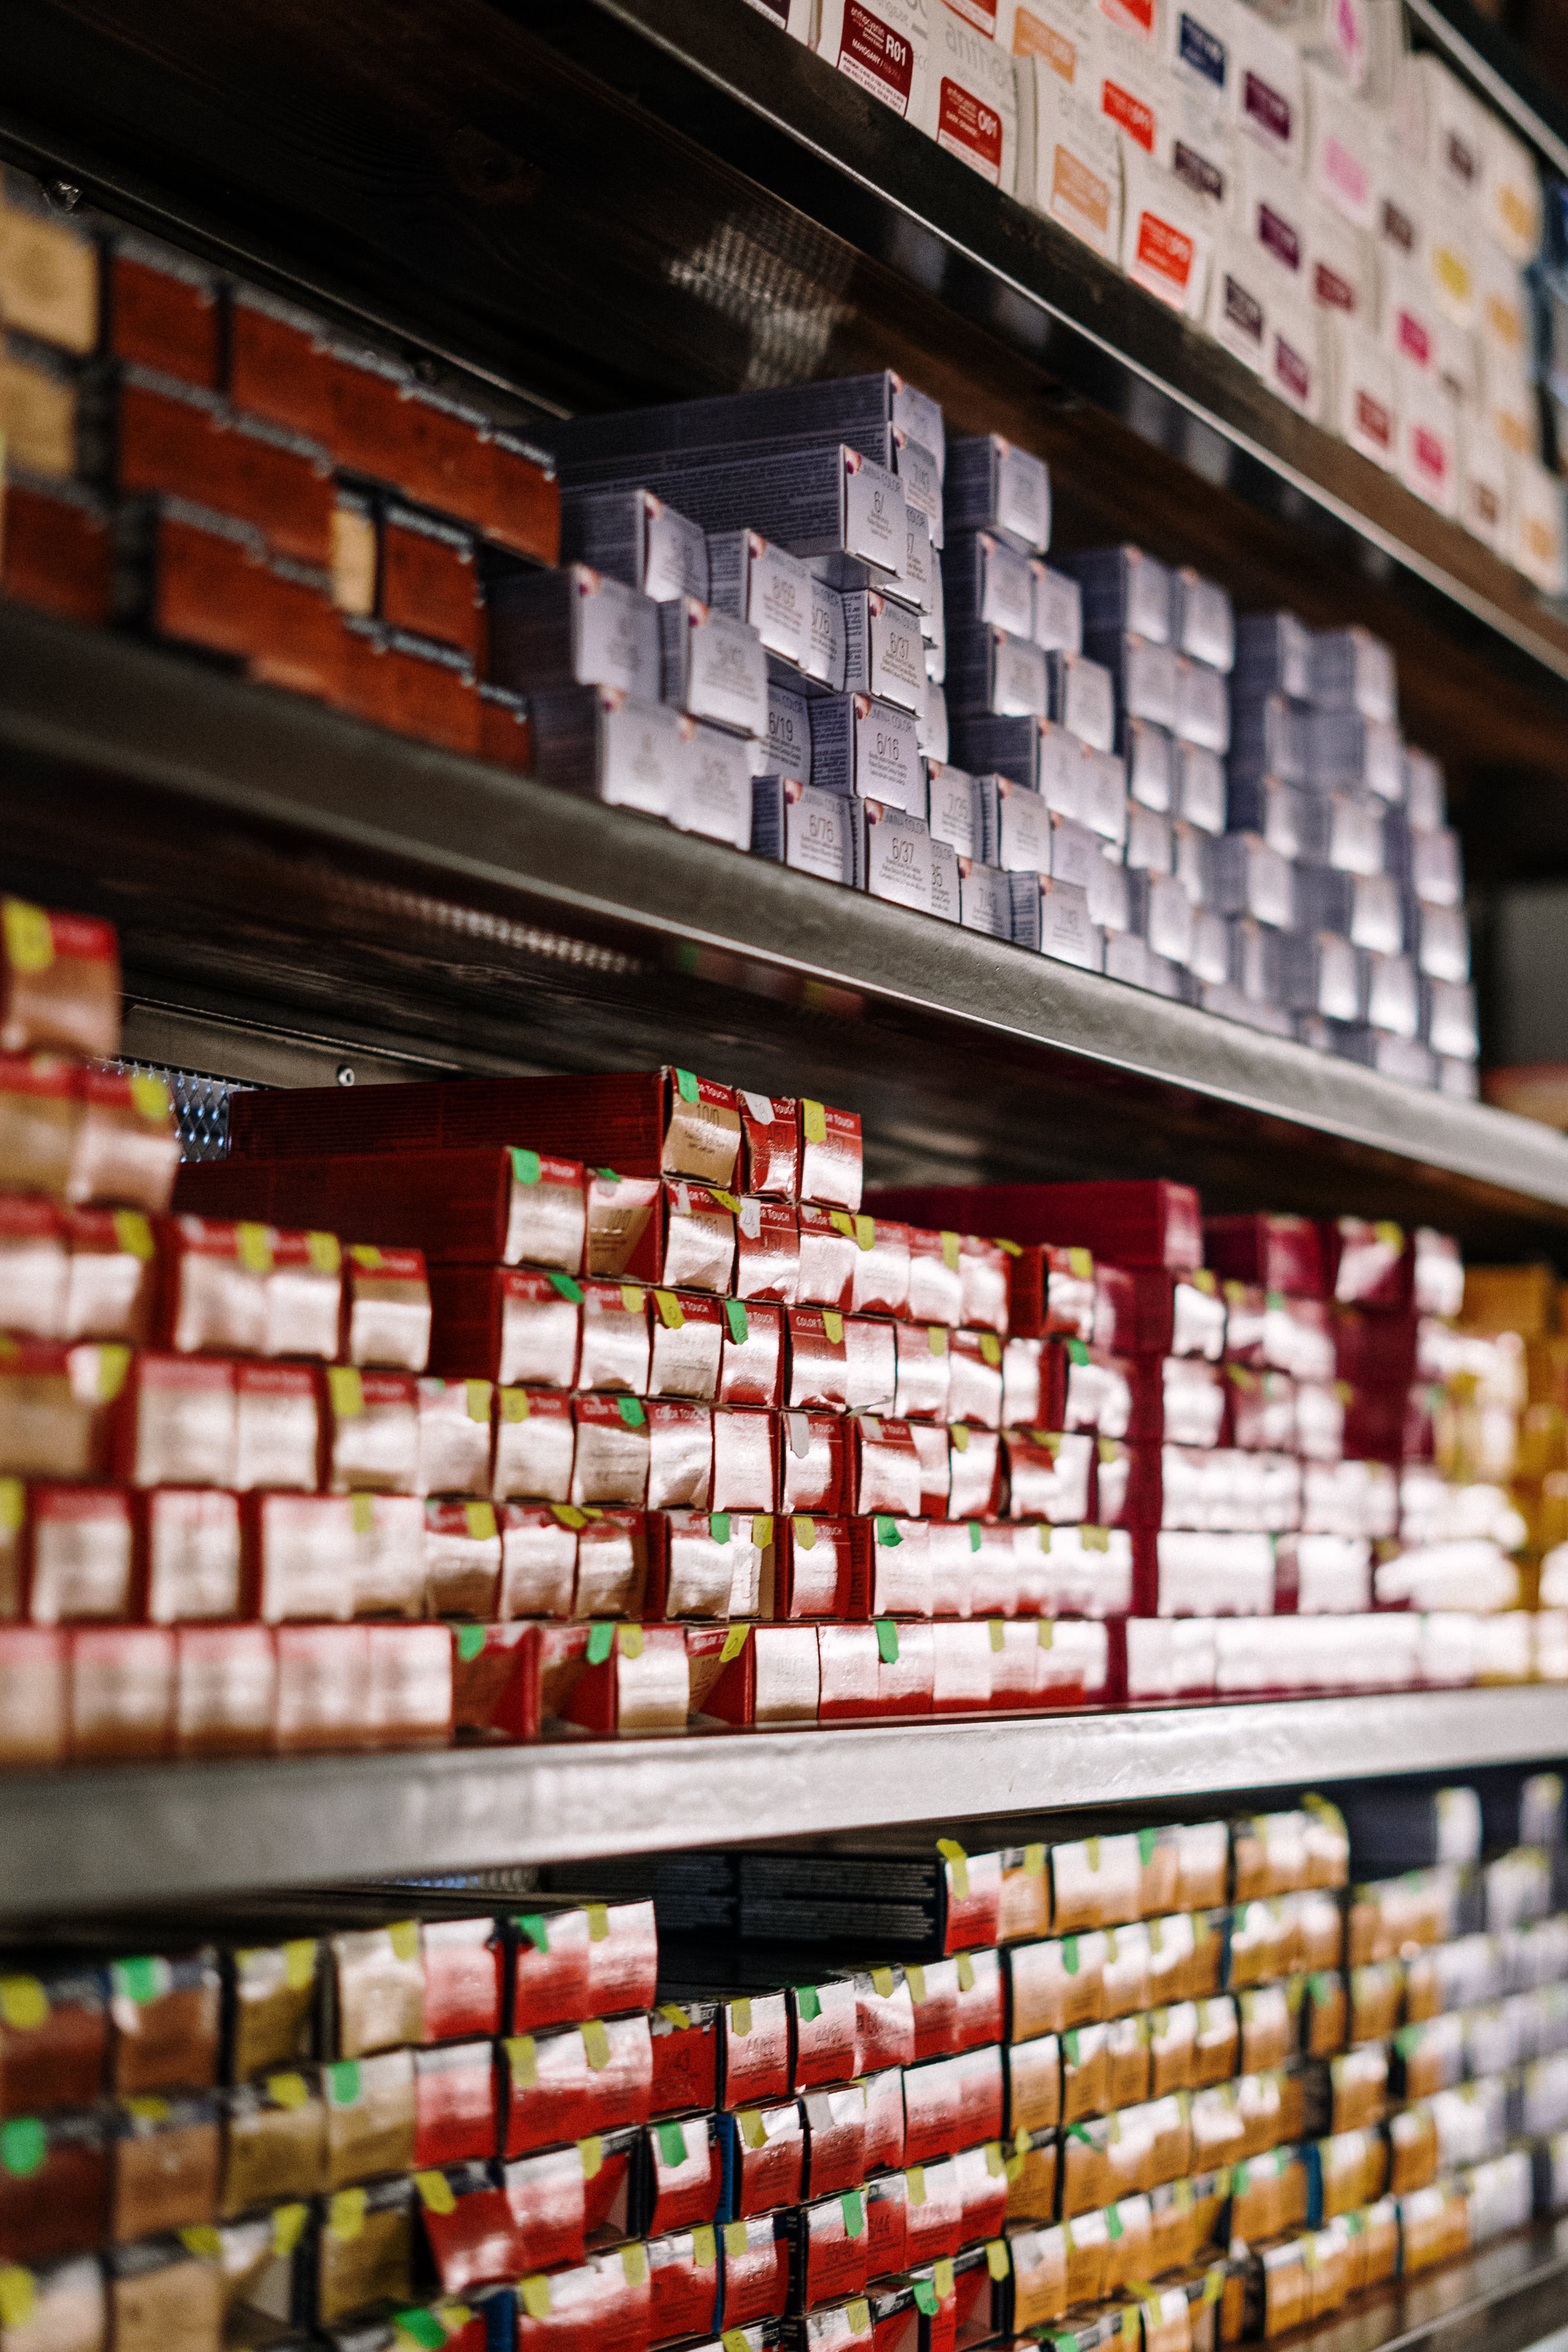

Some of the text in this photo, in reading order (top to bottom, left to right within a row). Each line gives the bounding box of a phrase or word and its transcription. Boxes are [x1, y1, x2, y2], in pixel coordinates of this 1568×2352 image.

[885, 34, 906, 66] R01
[890, 632, 910, 660] 6/37
[769, 711, 794, 742] 6/19
[877, 732, 899, 761] 6/16
[892, 837, 915, 864] 6/37
[704, 1084, 730, 1101] TOUCH
[833, 1113, 855, 1129] TOUCH
[767, 1209, 791, 1222] TOUCH
[685, 1296, 710, 1313] TOUCH
[752, 1311, 774, 1323] TOUCH
[796, 1315, 817, 1328] COLOR
